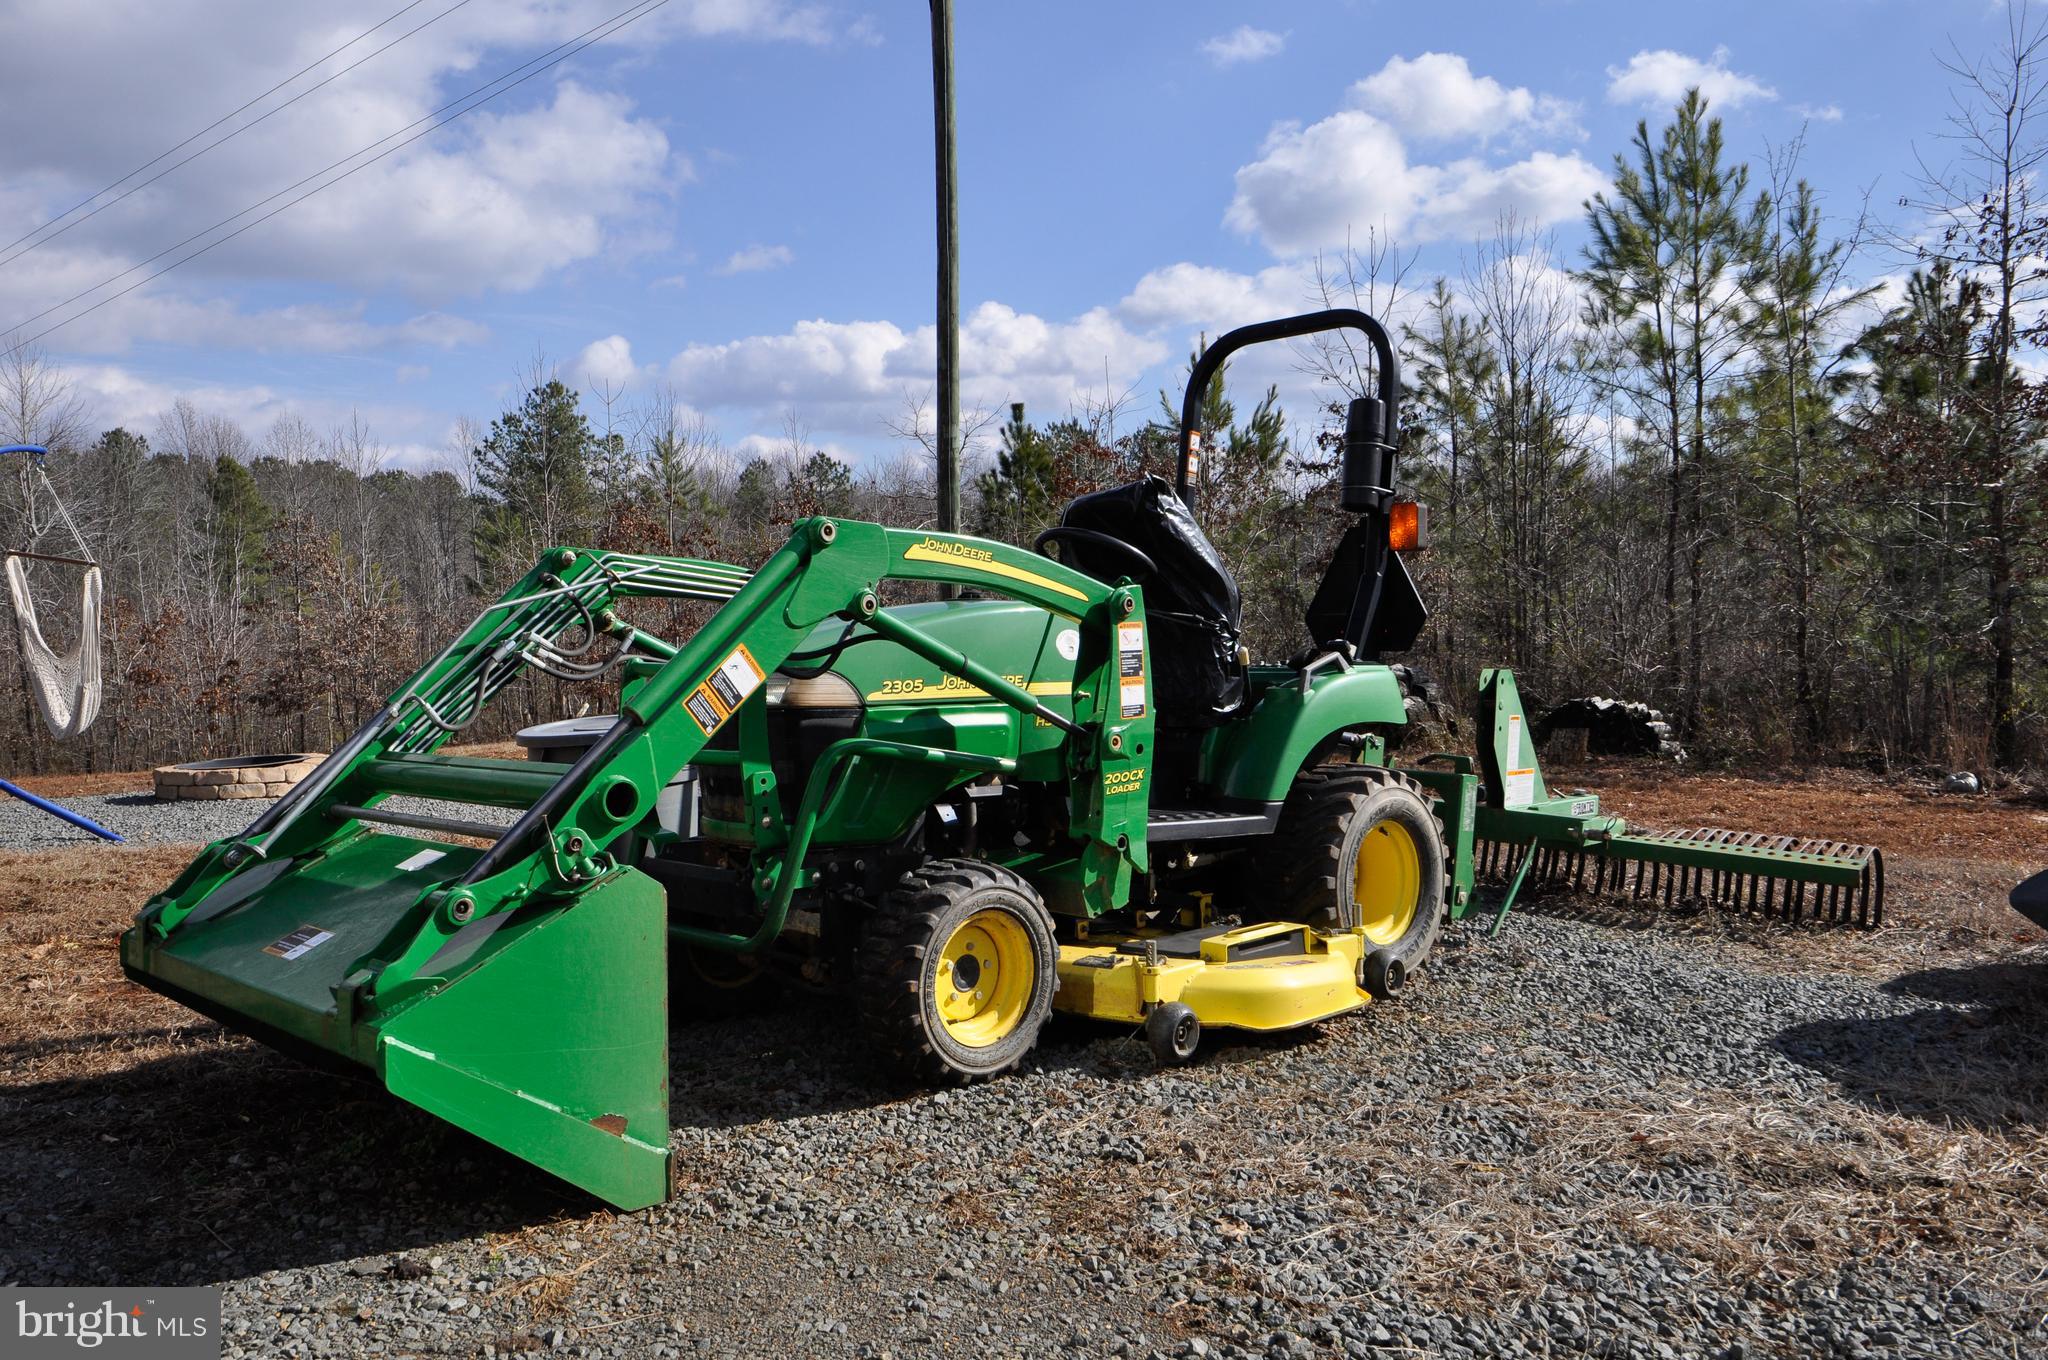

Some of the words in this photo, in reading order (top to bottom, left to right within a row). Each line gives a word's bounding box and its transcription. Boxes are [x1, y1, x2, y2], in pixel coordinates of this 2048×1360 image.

[919, 536, 953, 554] JOHN
[953, 543, 994, 563] DEERE
[882, 679, 924, 694] 2305
[1104, 769, 1145, 785] 200CX
[1106, 782, 1141, 795] LOADER
